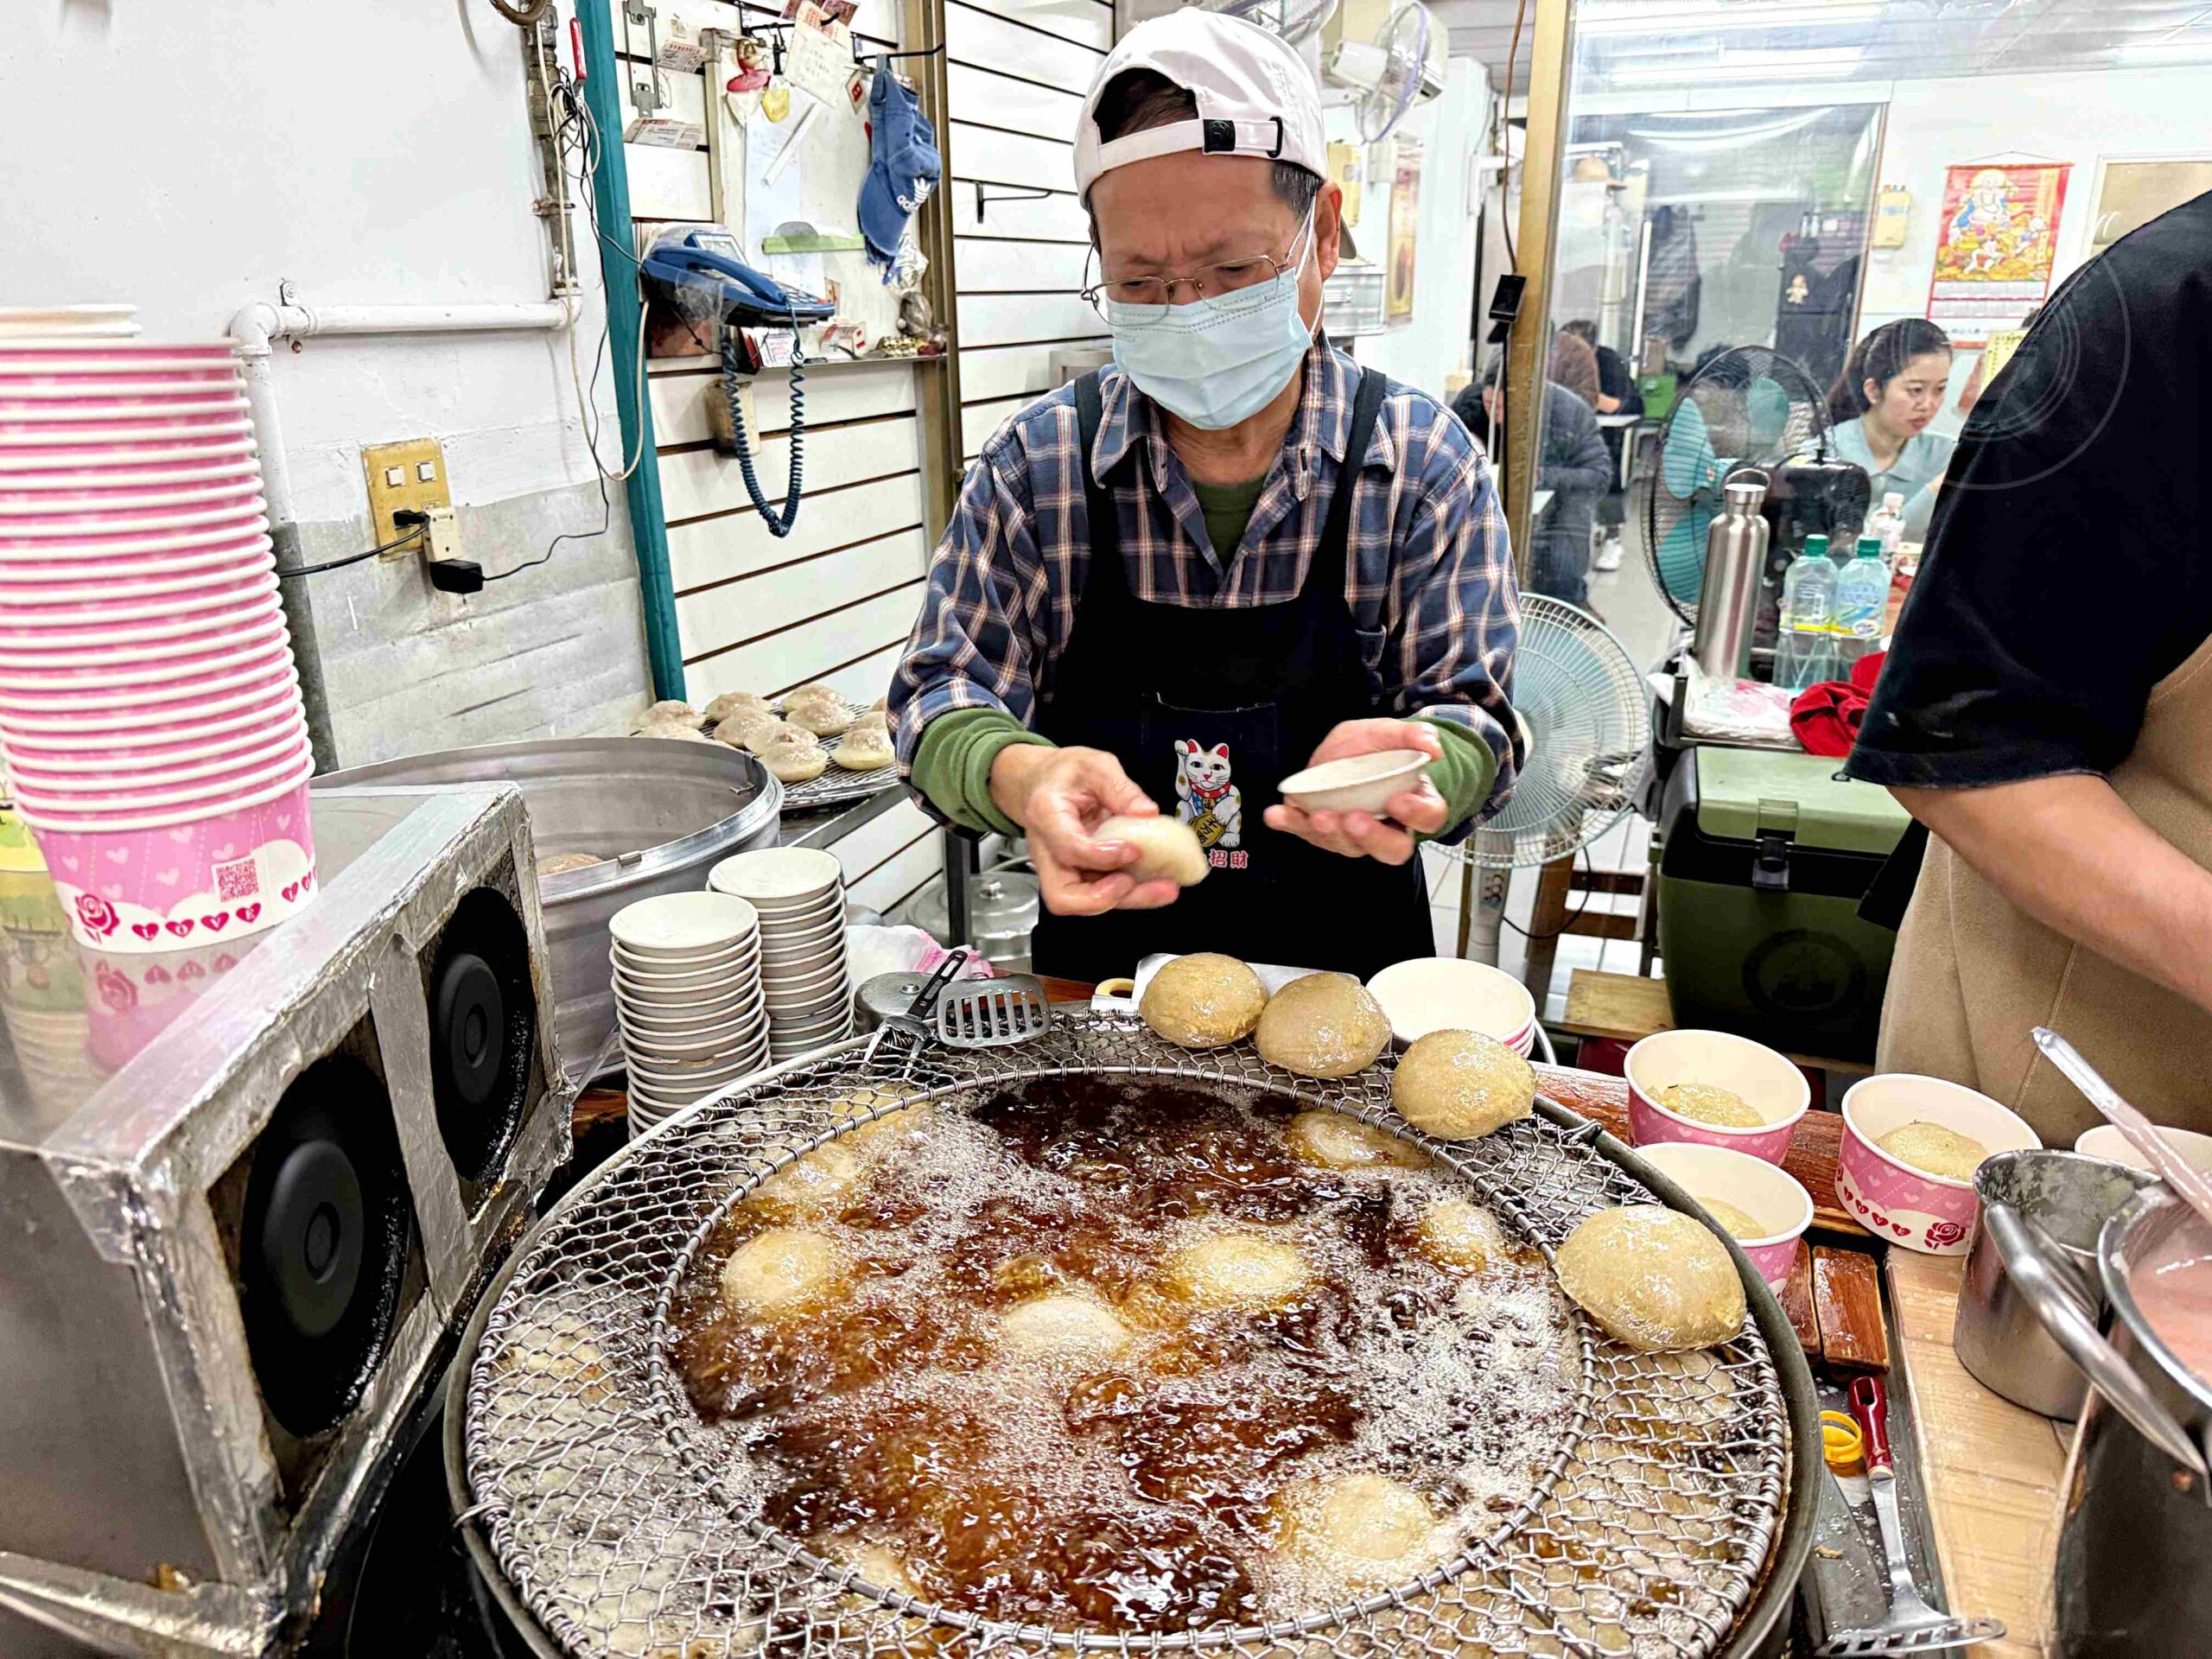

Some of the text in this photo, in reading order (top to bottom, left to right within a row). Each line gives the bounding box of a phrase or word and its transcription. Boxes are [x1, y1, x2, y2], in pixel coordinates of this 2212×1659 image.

[1209, 849, 1249, 868] 招財
[137, 905, 259, 940] LOVE
[1845, 1188, 1908, 1236] LOVE
